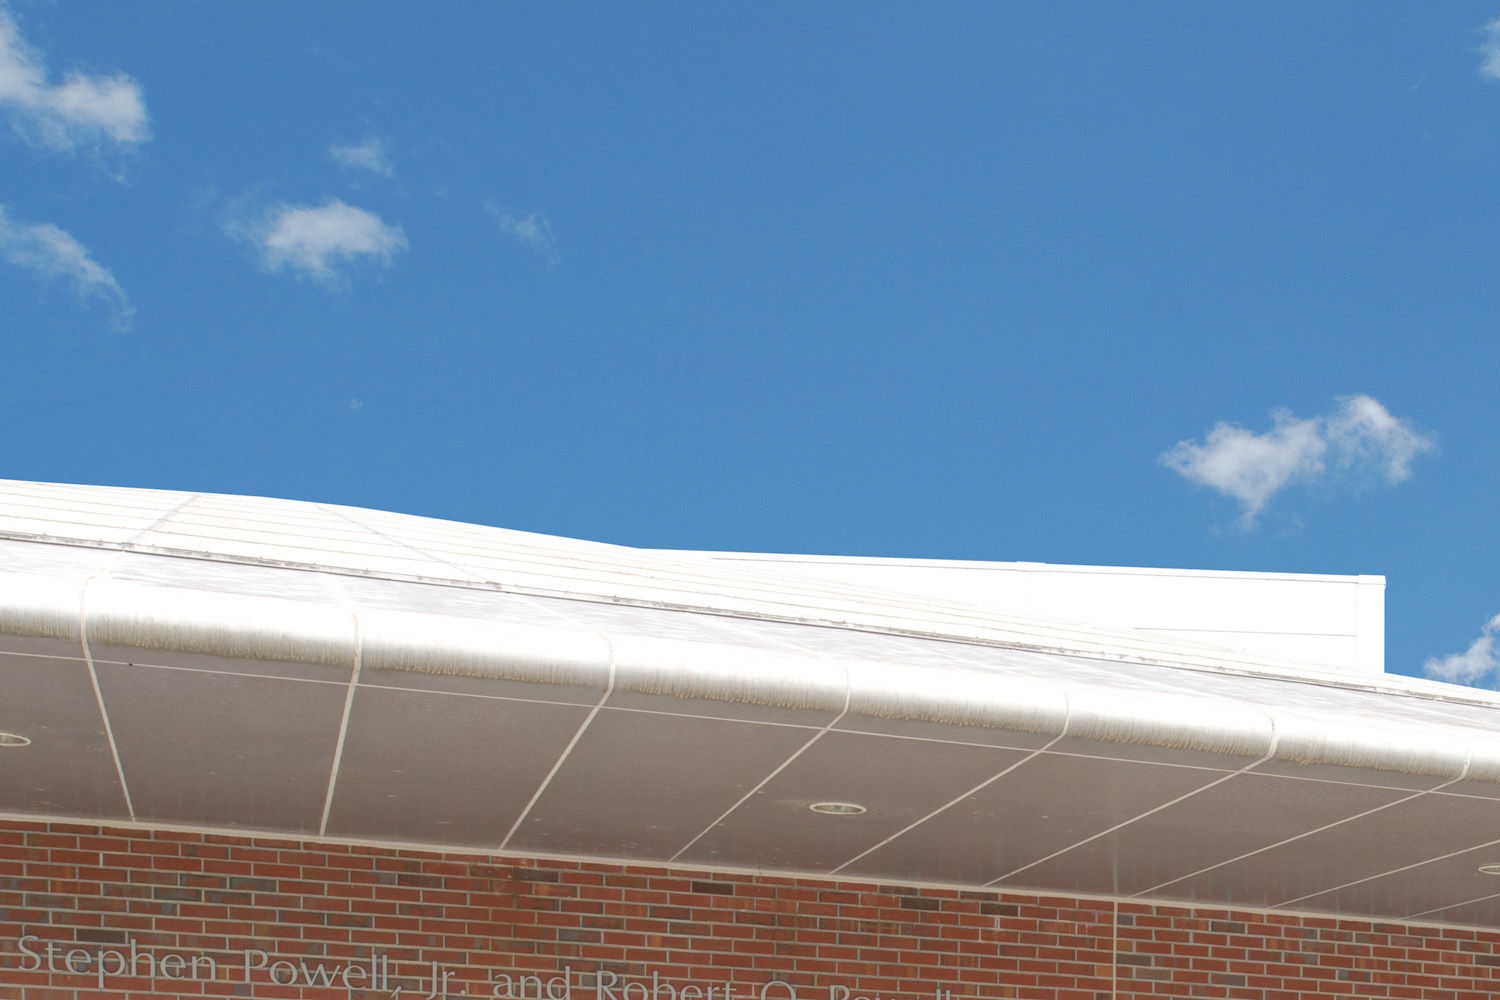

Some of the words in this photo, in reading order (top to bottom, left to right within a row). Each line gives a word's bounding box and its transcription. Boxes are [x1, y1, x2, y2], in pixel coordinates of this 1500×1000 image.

[17, 934, 217, 989] Stephen
[244, 948, 402, 1000] Powell,
[425, 959, 468, 1000] Jr.
[492, 966, 571, 1000] and
